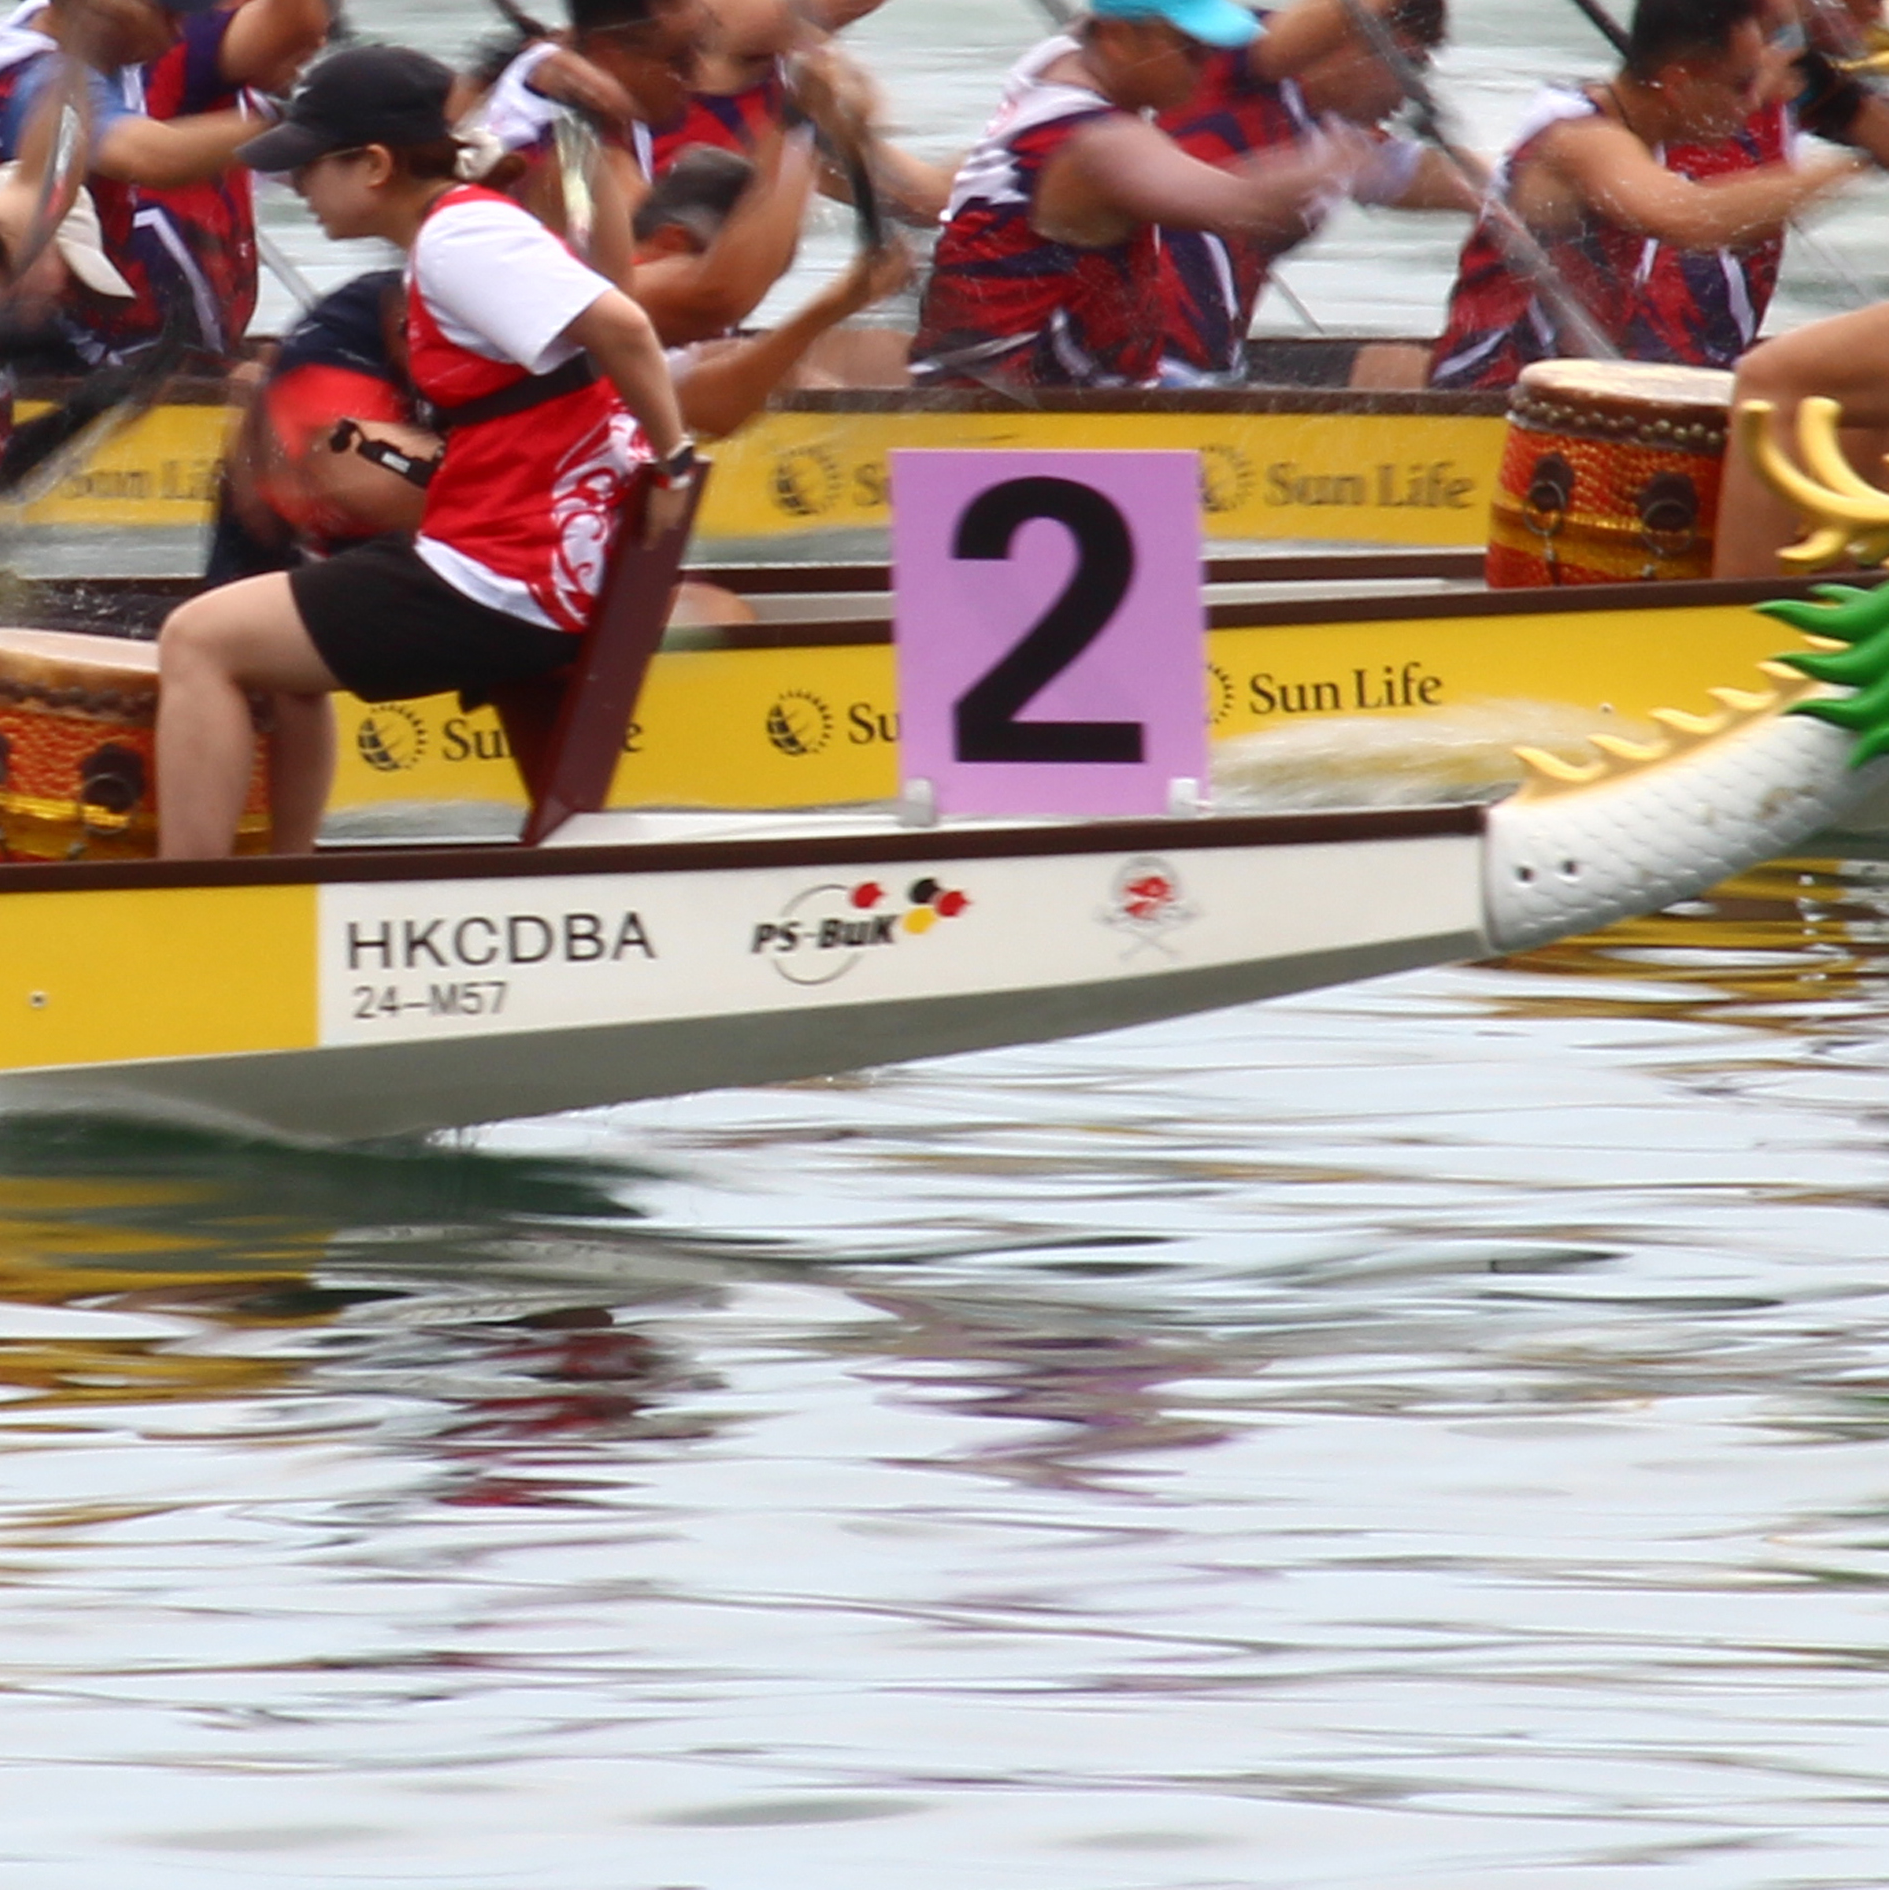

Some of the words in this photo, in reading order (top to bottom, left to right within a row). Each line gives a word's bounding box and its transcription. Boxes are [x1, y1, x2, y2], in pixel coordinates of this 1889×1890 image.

[1264, 463, 1366, 505] Sun
[1377, 460, 1473, 509] Life
[949, 476, 1146, 763] 2
[1248, 672, 1342, 715] Sun
[1352, 660, 1443, 709] Life
[441, 718, 512, 762] Su
[346, 911, 657, 970] HKCDBA
[750, 914, 900, 954] PS-BuK
